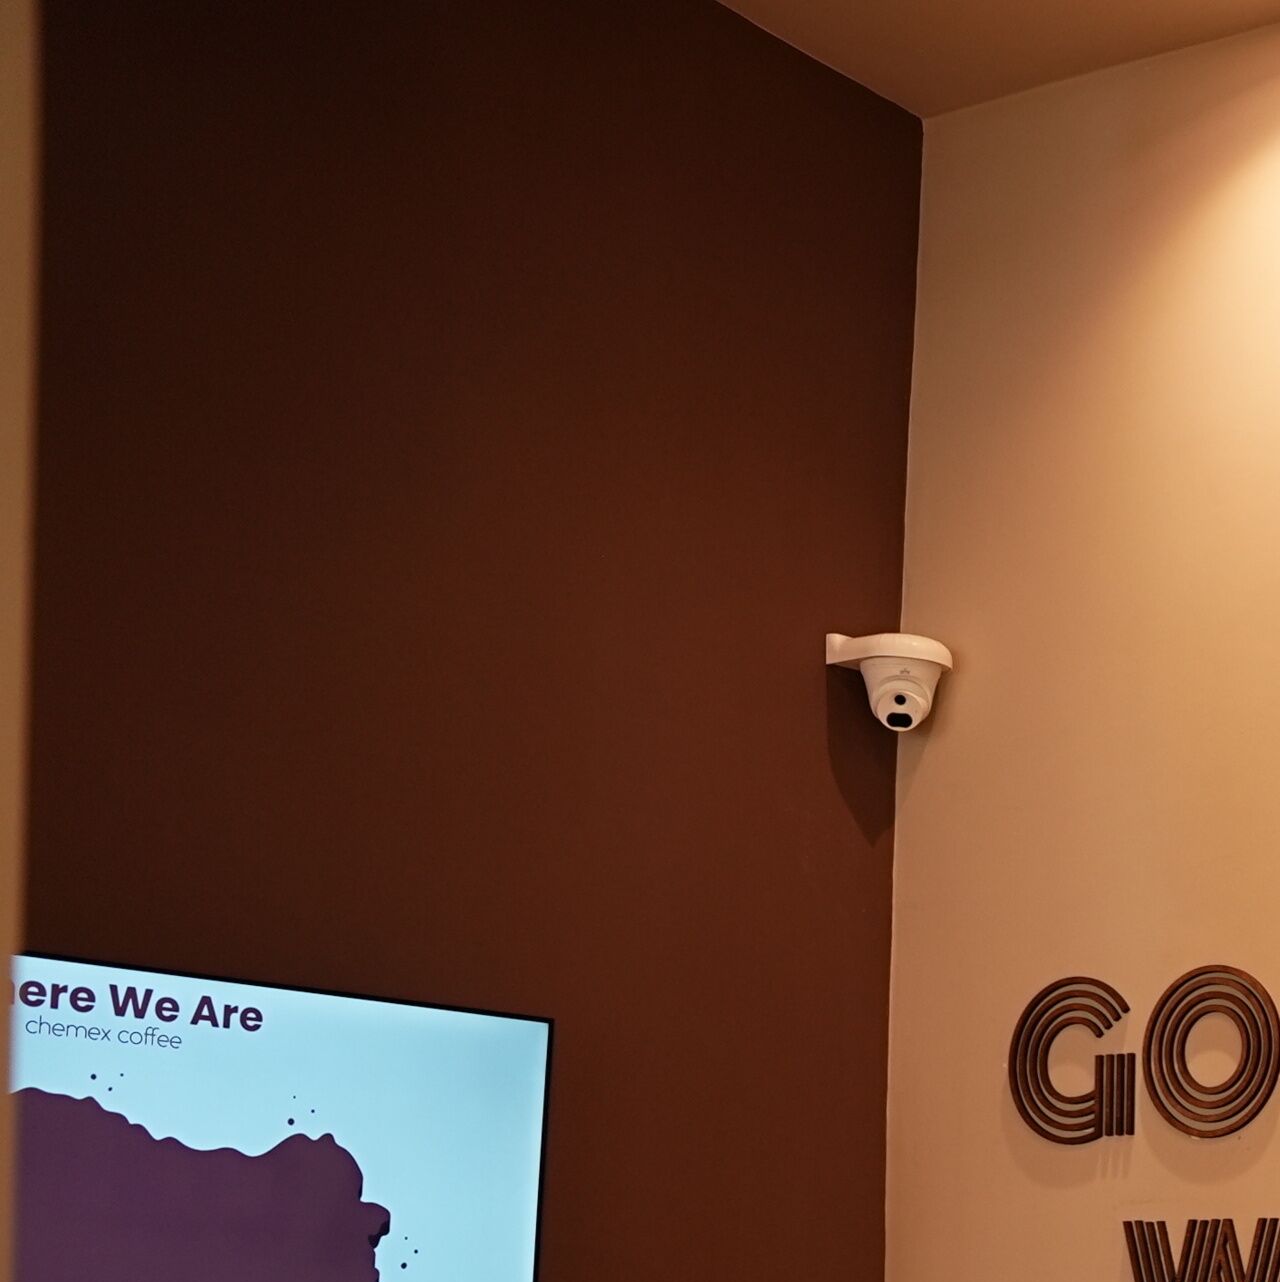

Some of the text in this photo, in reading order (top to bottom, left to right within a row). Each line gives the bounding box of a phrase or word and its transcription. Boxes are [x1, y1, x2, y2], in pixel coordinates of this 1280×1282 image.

[10, 978, 263, 1032] ere We Are
[25, 1015, 182, 1049] chemex coffee
